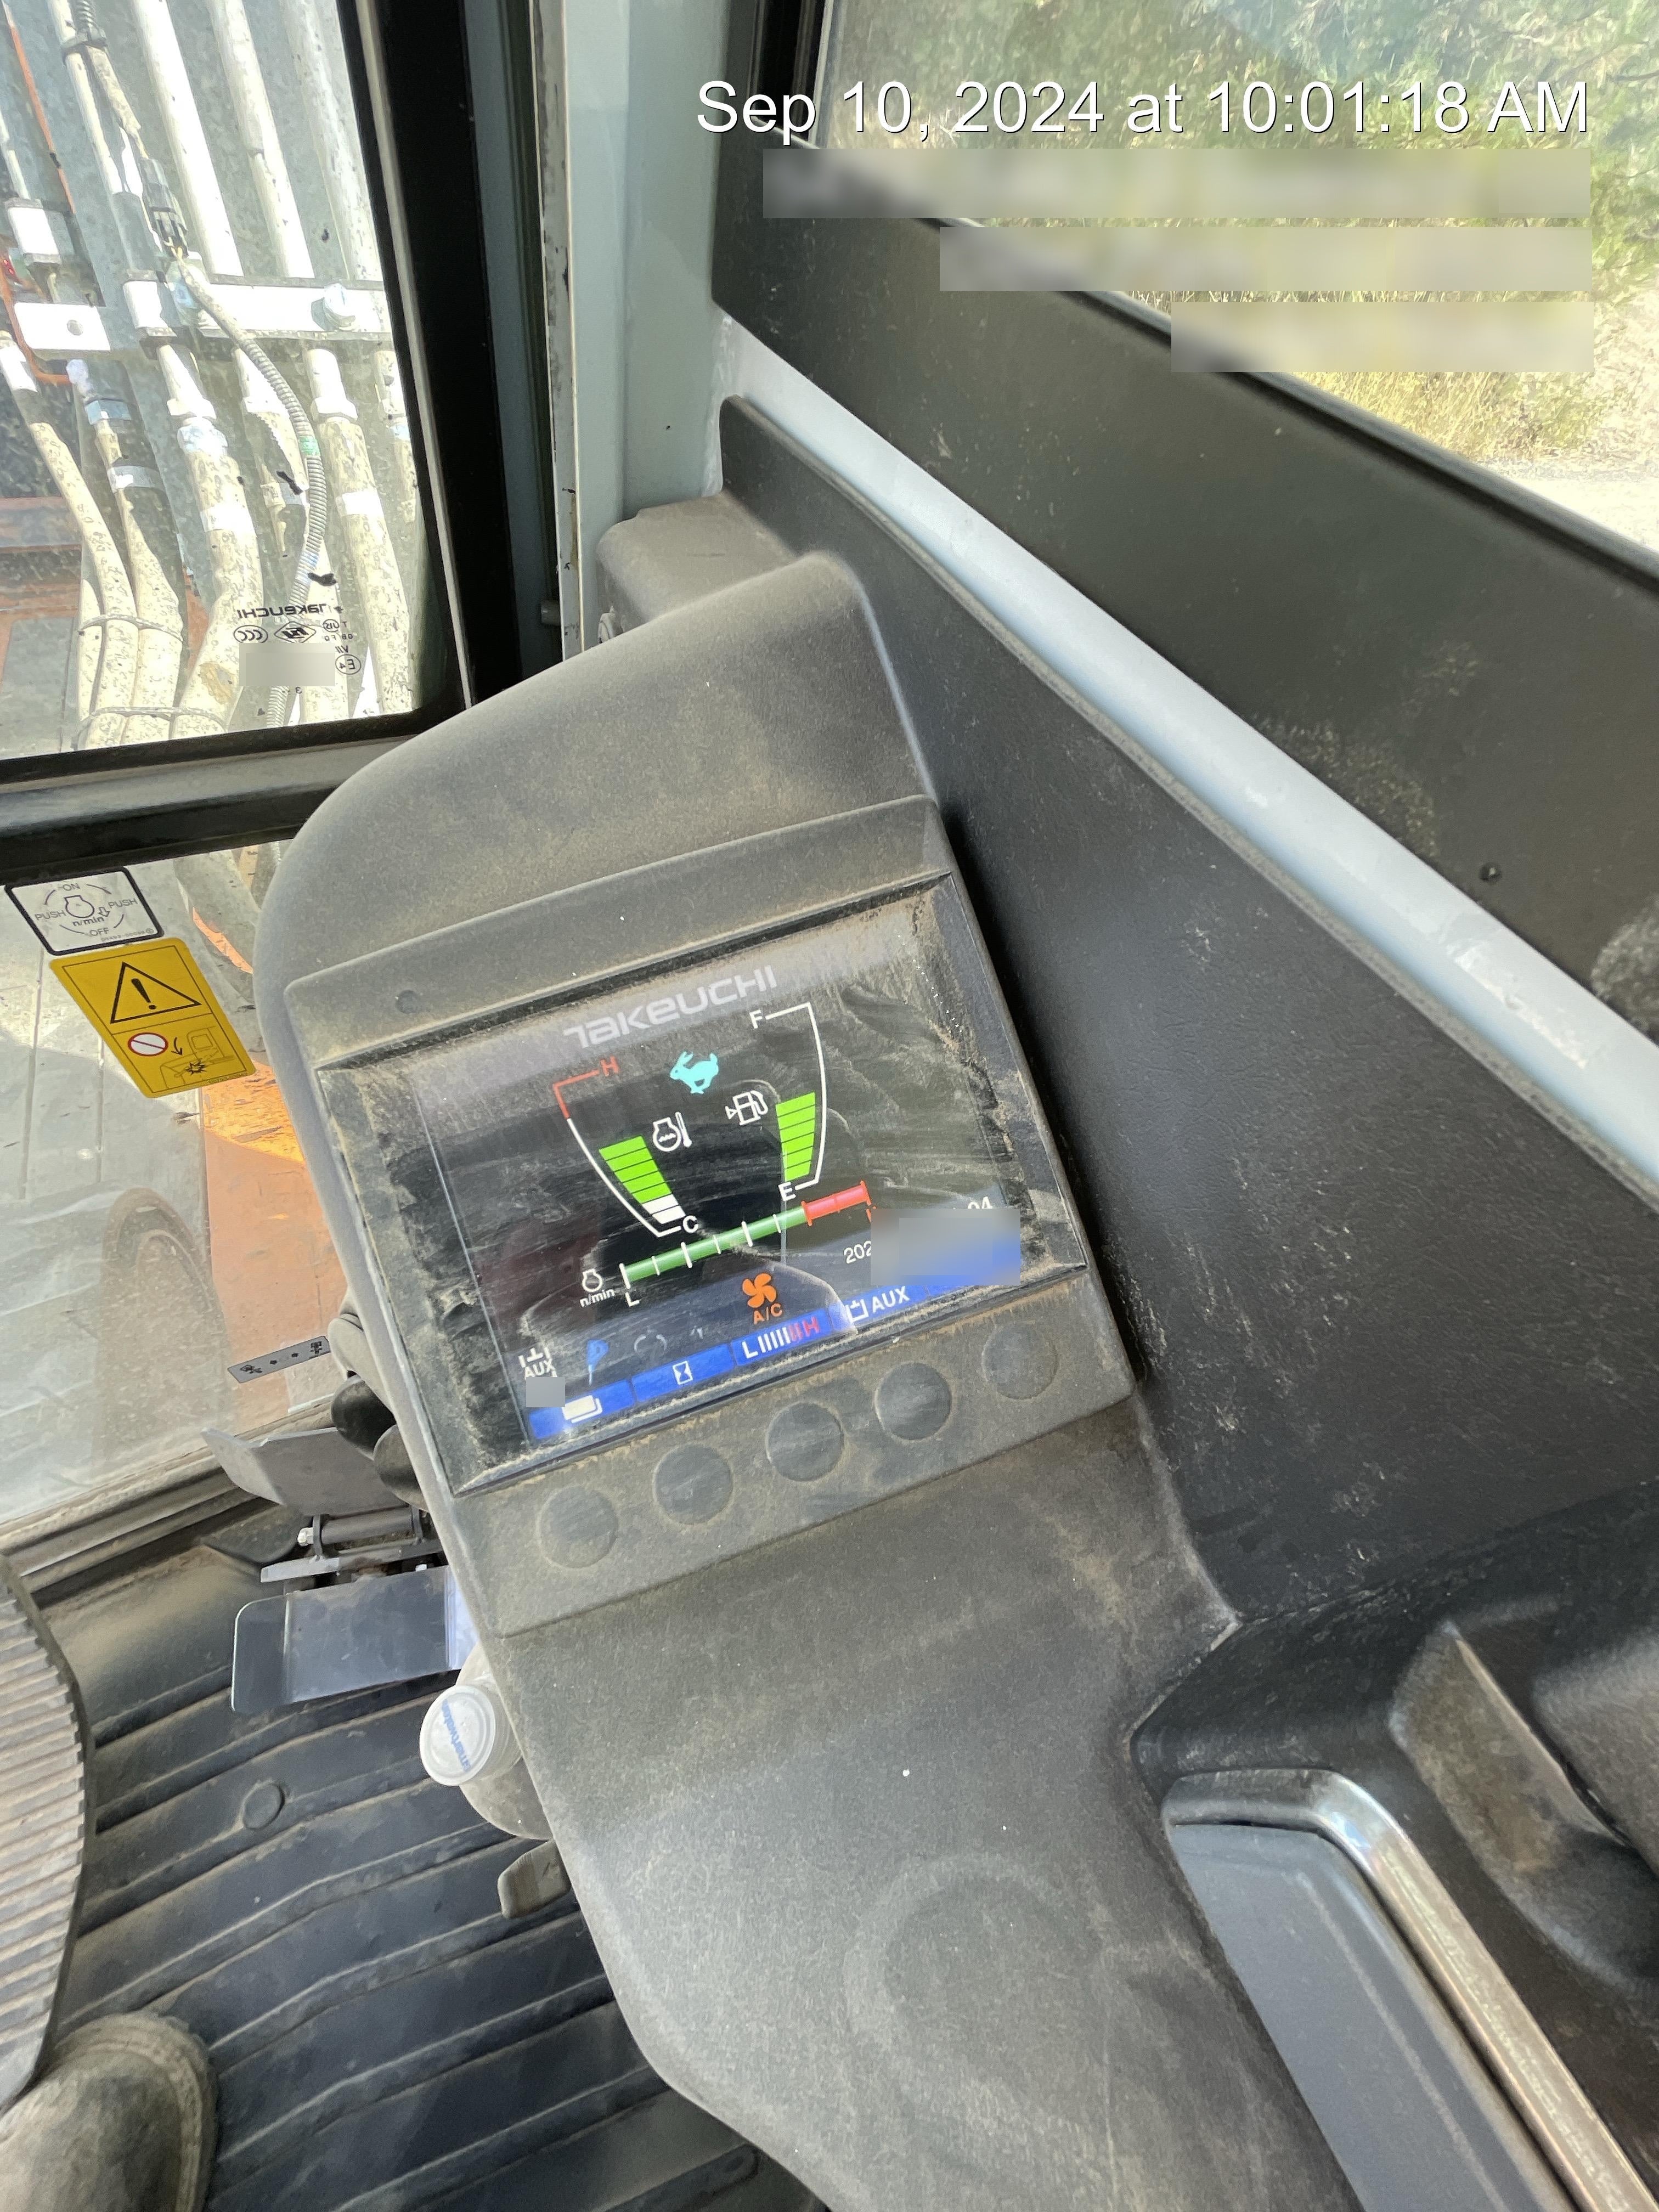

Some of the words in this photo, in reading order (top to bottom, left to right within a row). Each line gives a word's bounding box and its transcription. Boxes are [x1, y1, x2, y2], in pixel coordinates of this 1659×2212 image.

[63, 883, 81, 891] ON
[108, 898, 138, 909] PUSH
[35, 910, 66, 921] PUSH
[72, 916, 105, 927] n/min
[89, 927, 110, 937] OFF
[749, 1009, 765, 1030] F
[600, 1055, 620, 1077] H
[778, 1182, 797, 1201] E
[682, 1214, 699, 1234] C
[579, 1288, 615, 1307] n/min
[625, 1291, 640, 1307] L
[871, 1285, 911, 1313] AUX
[753, 1302, 783, 1324] A/C
